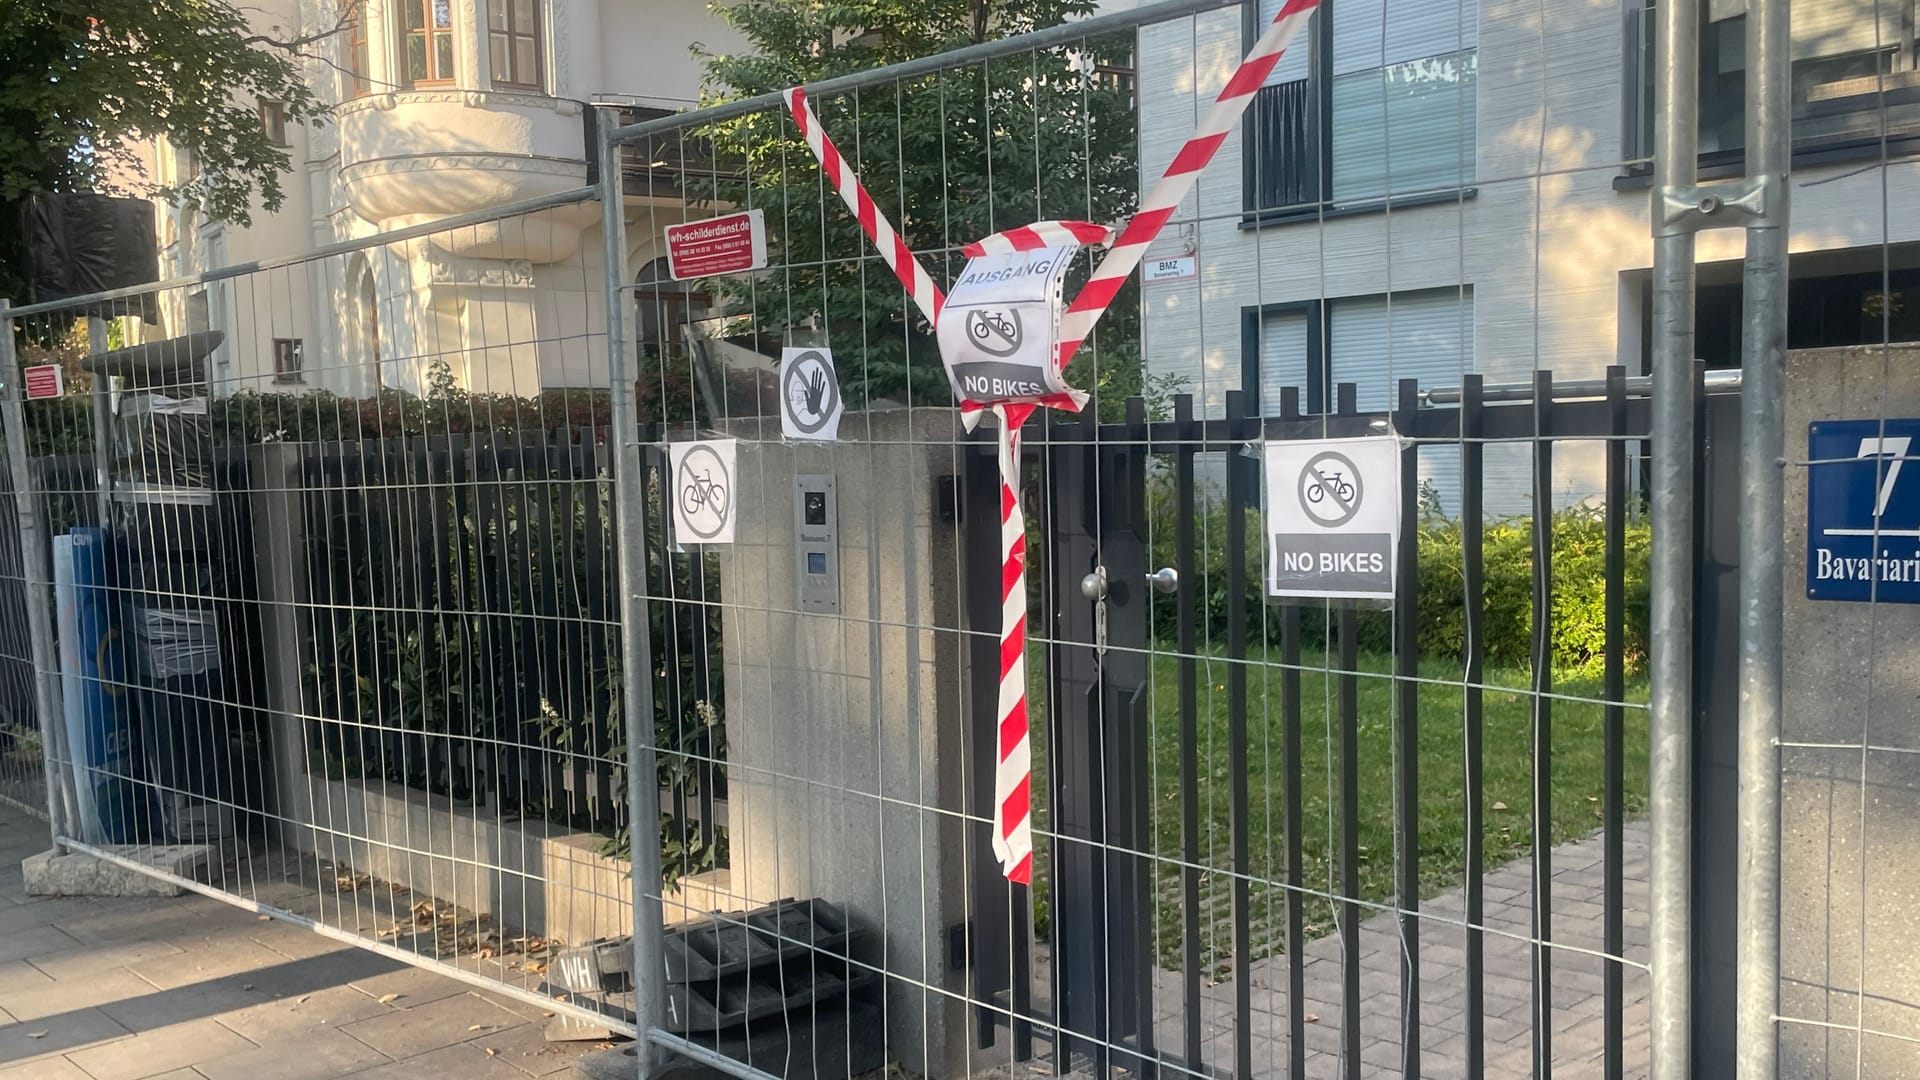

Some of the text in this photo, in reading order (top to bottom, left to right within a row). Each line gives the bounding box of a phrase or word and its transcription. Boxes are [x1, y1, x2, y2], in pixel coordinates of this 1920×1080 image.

[670, 220, 750, 243] wh-schilderdienst.de
[961, 260, 1052, 286] AUSGANG
[1159, 260, 1178, 271] BMZ
[964, 375, 1044, 397] NO BIKES
[1857, 437, 1912, 516] 7
[1284, 552, 1384, 573] NO BIKES
